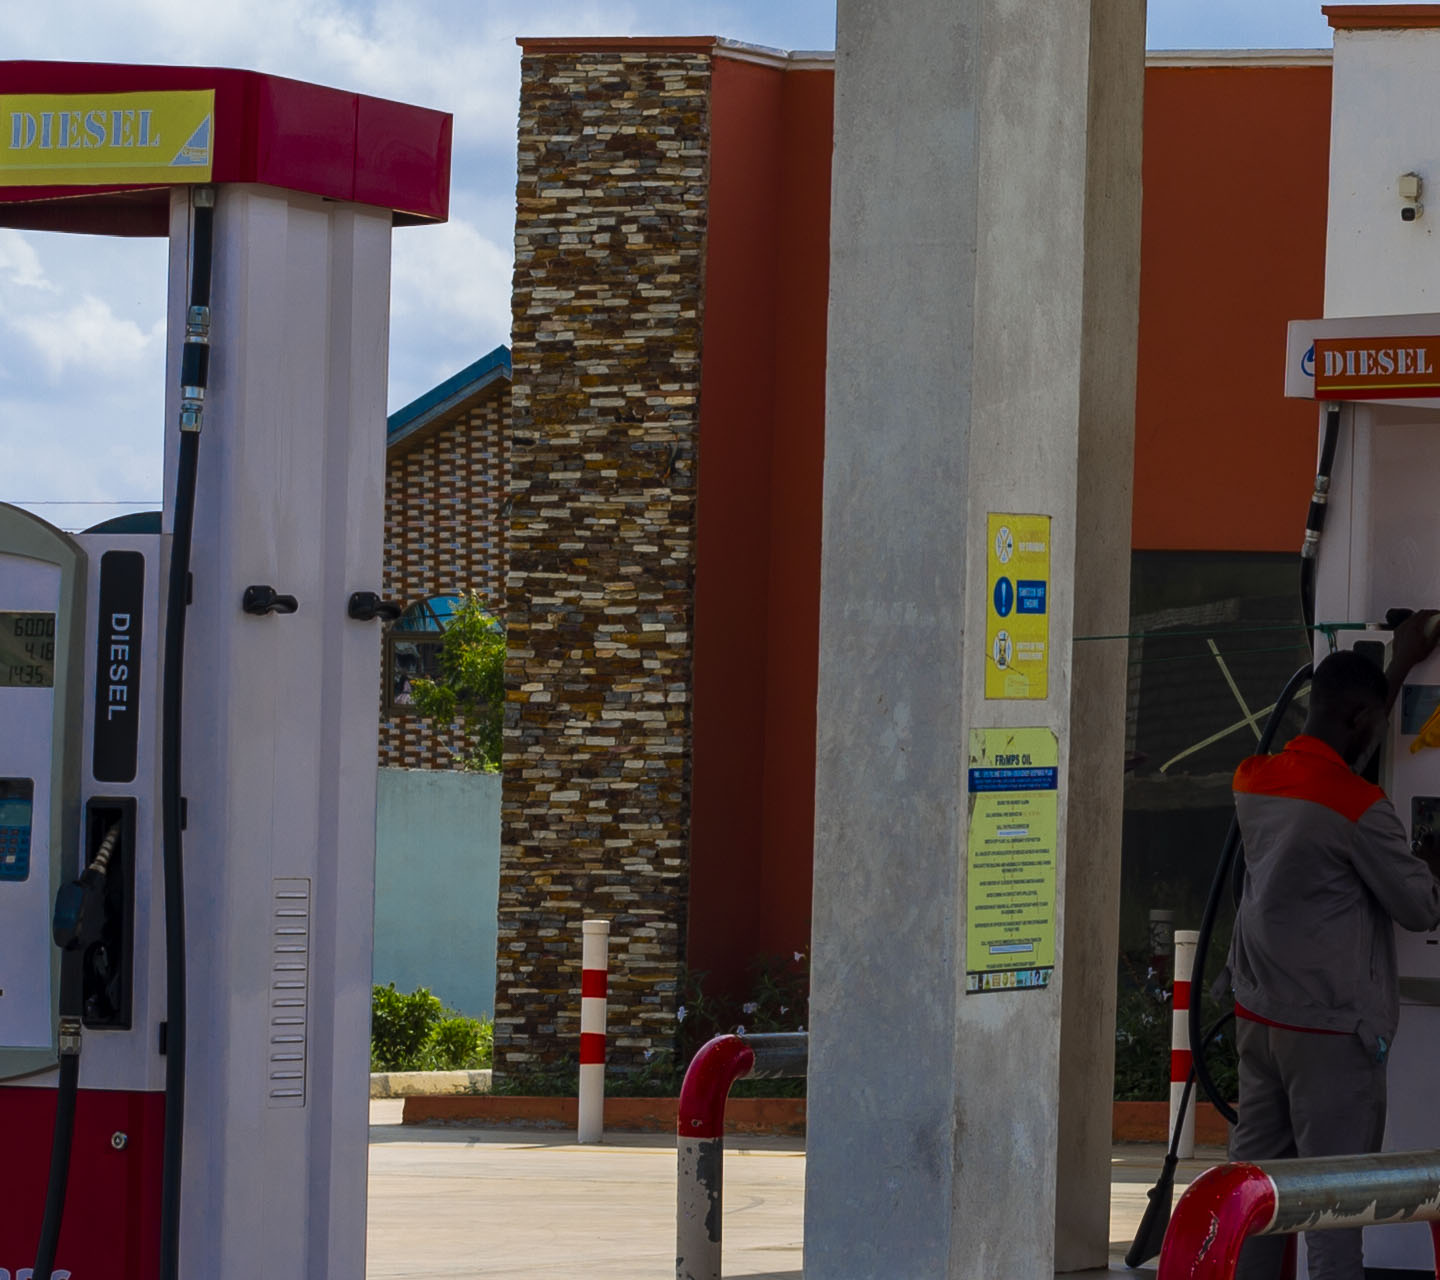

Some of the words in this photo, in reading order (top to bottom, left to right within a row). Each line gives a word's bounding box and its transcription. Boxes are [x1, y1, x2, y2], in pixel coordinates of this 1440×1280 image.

[8, 109, 160, 150] DIESEL
[1323, 348, 1433, 377] DIESEL
[108, 613, 130, 721] DIESEL
[1021, 753, 1033, 766] OIL
